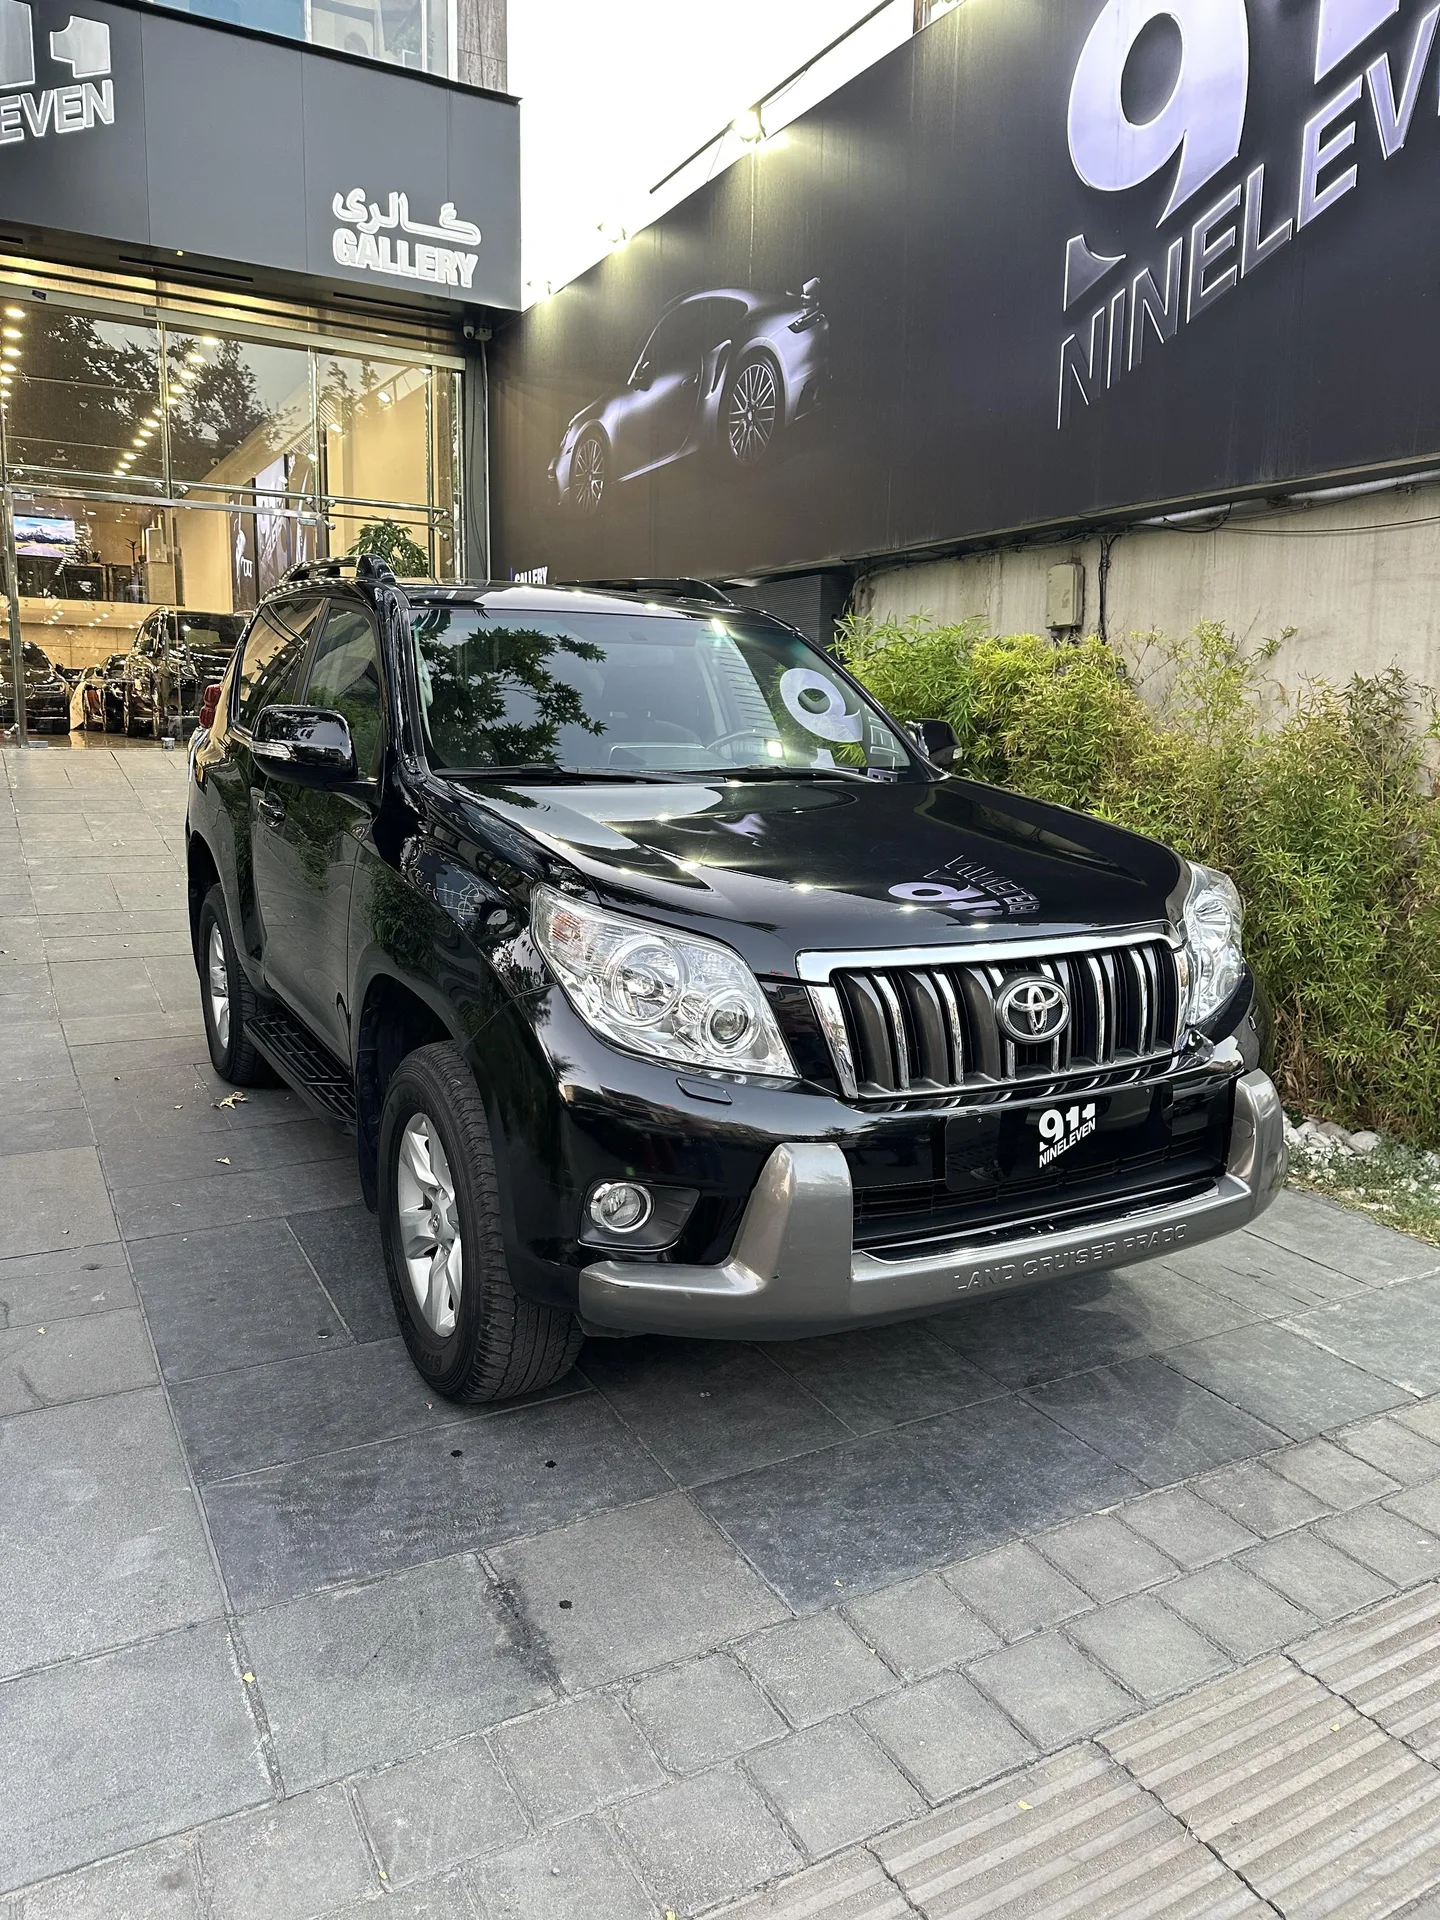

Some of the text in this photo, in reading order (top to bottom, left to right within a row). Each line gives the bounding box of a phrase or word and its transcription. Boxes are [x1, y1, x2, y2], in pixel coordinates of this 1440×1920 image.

[0, 79, 115, 145] EVEN
[332, 187, 482, 246] گالری
[1057, 3, 1440, 430] NINELEV
[332, 227, 479, 289] GALLERY
[1038, 1117, 1096, 1169] NINELEVEN
[1039, 1102, 1096, 1152] 911
[952, 1223, 1188, 1290] LAND CRUISER PRADO
